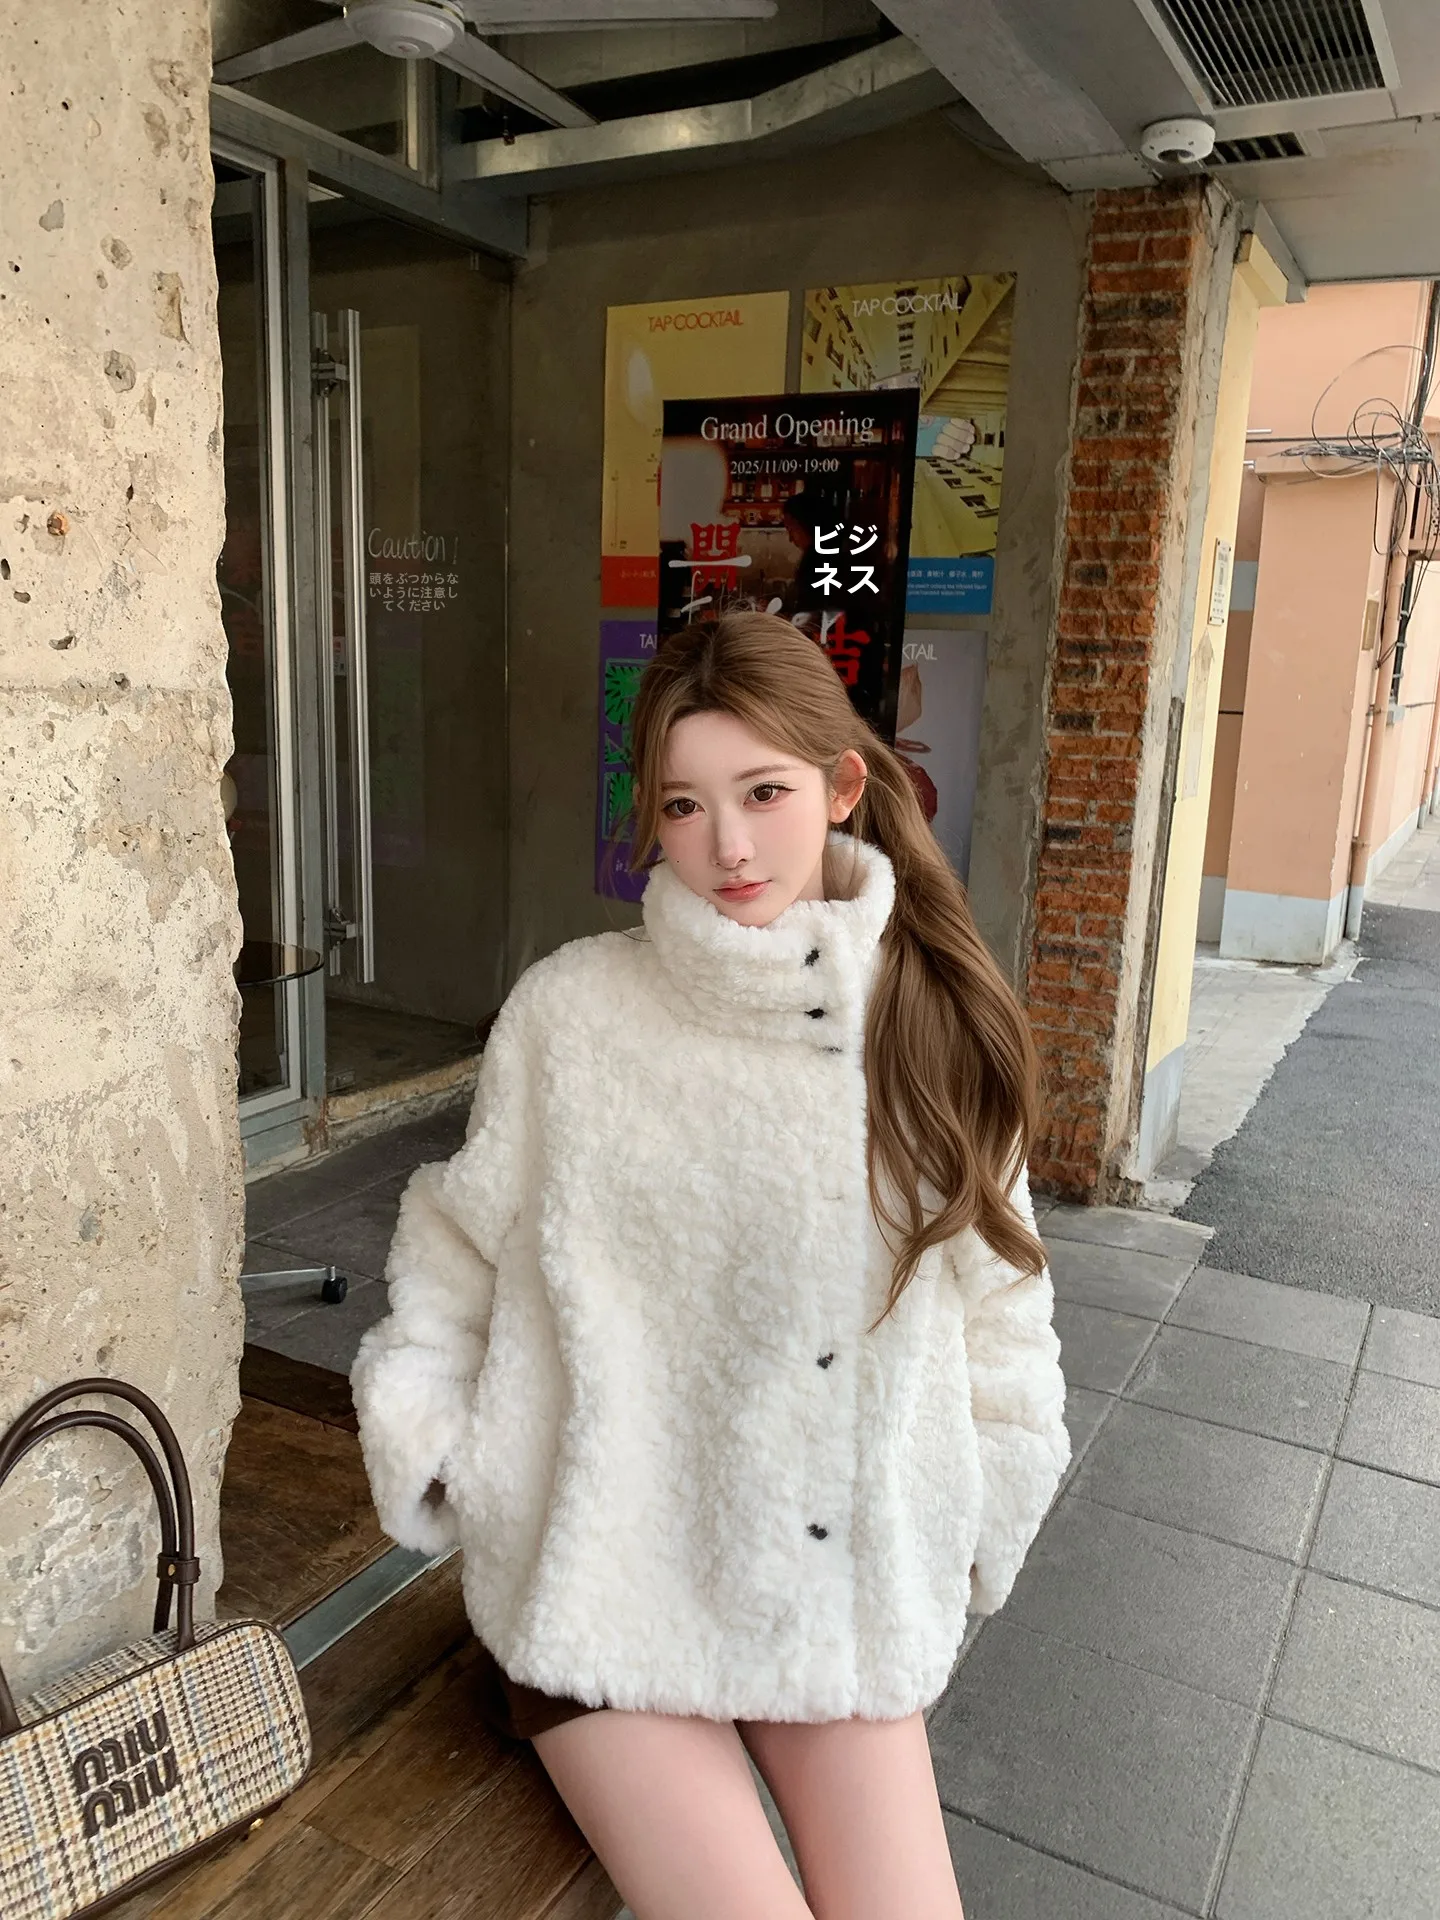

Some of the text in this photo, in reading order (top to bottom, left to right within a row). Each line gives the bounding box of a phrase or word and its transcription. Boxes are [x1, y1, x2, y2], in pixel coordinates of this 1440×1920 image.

[700, 411, 875, 445] Grand Opening
[369, 572, 459, 585] 頭をぶつからな
[369, 586, 459, 599] いように注意し
[383, 599, 446, 612] てください
[640, 633, 658, 650] TA
[902, 643, 938, 661] KTAIL
